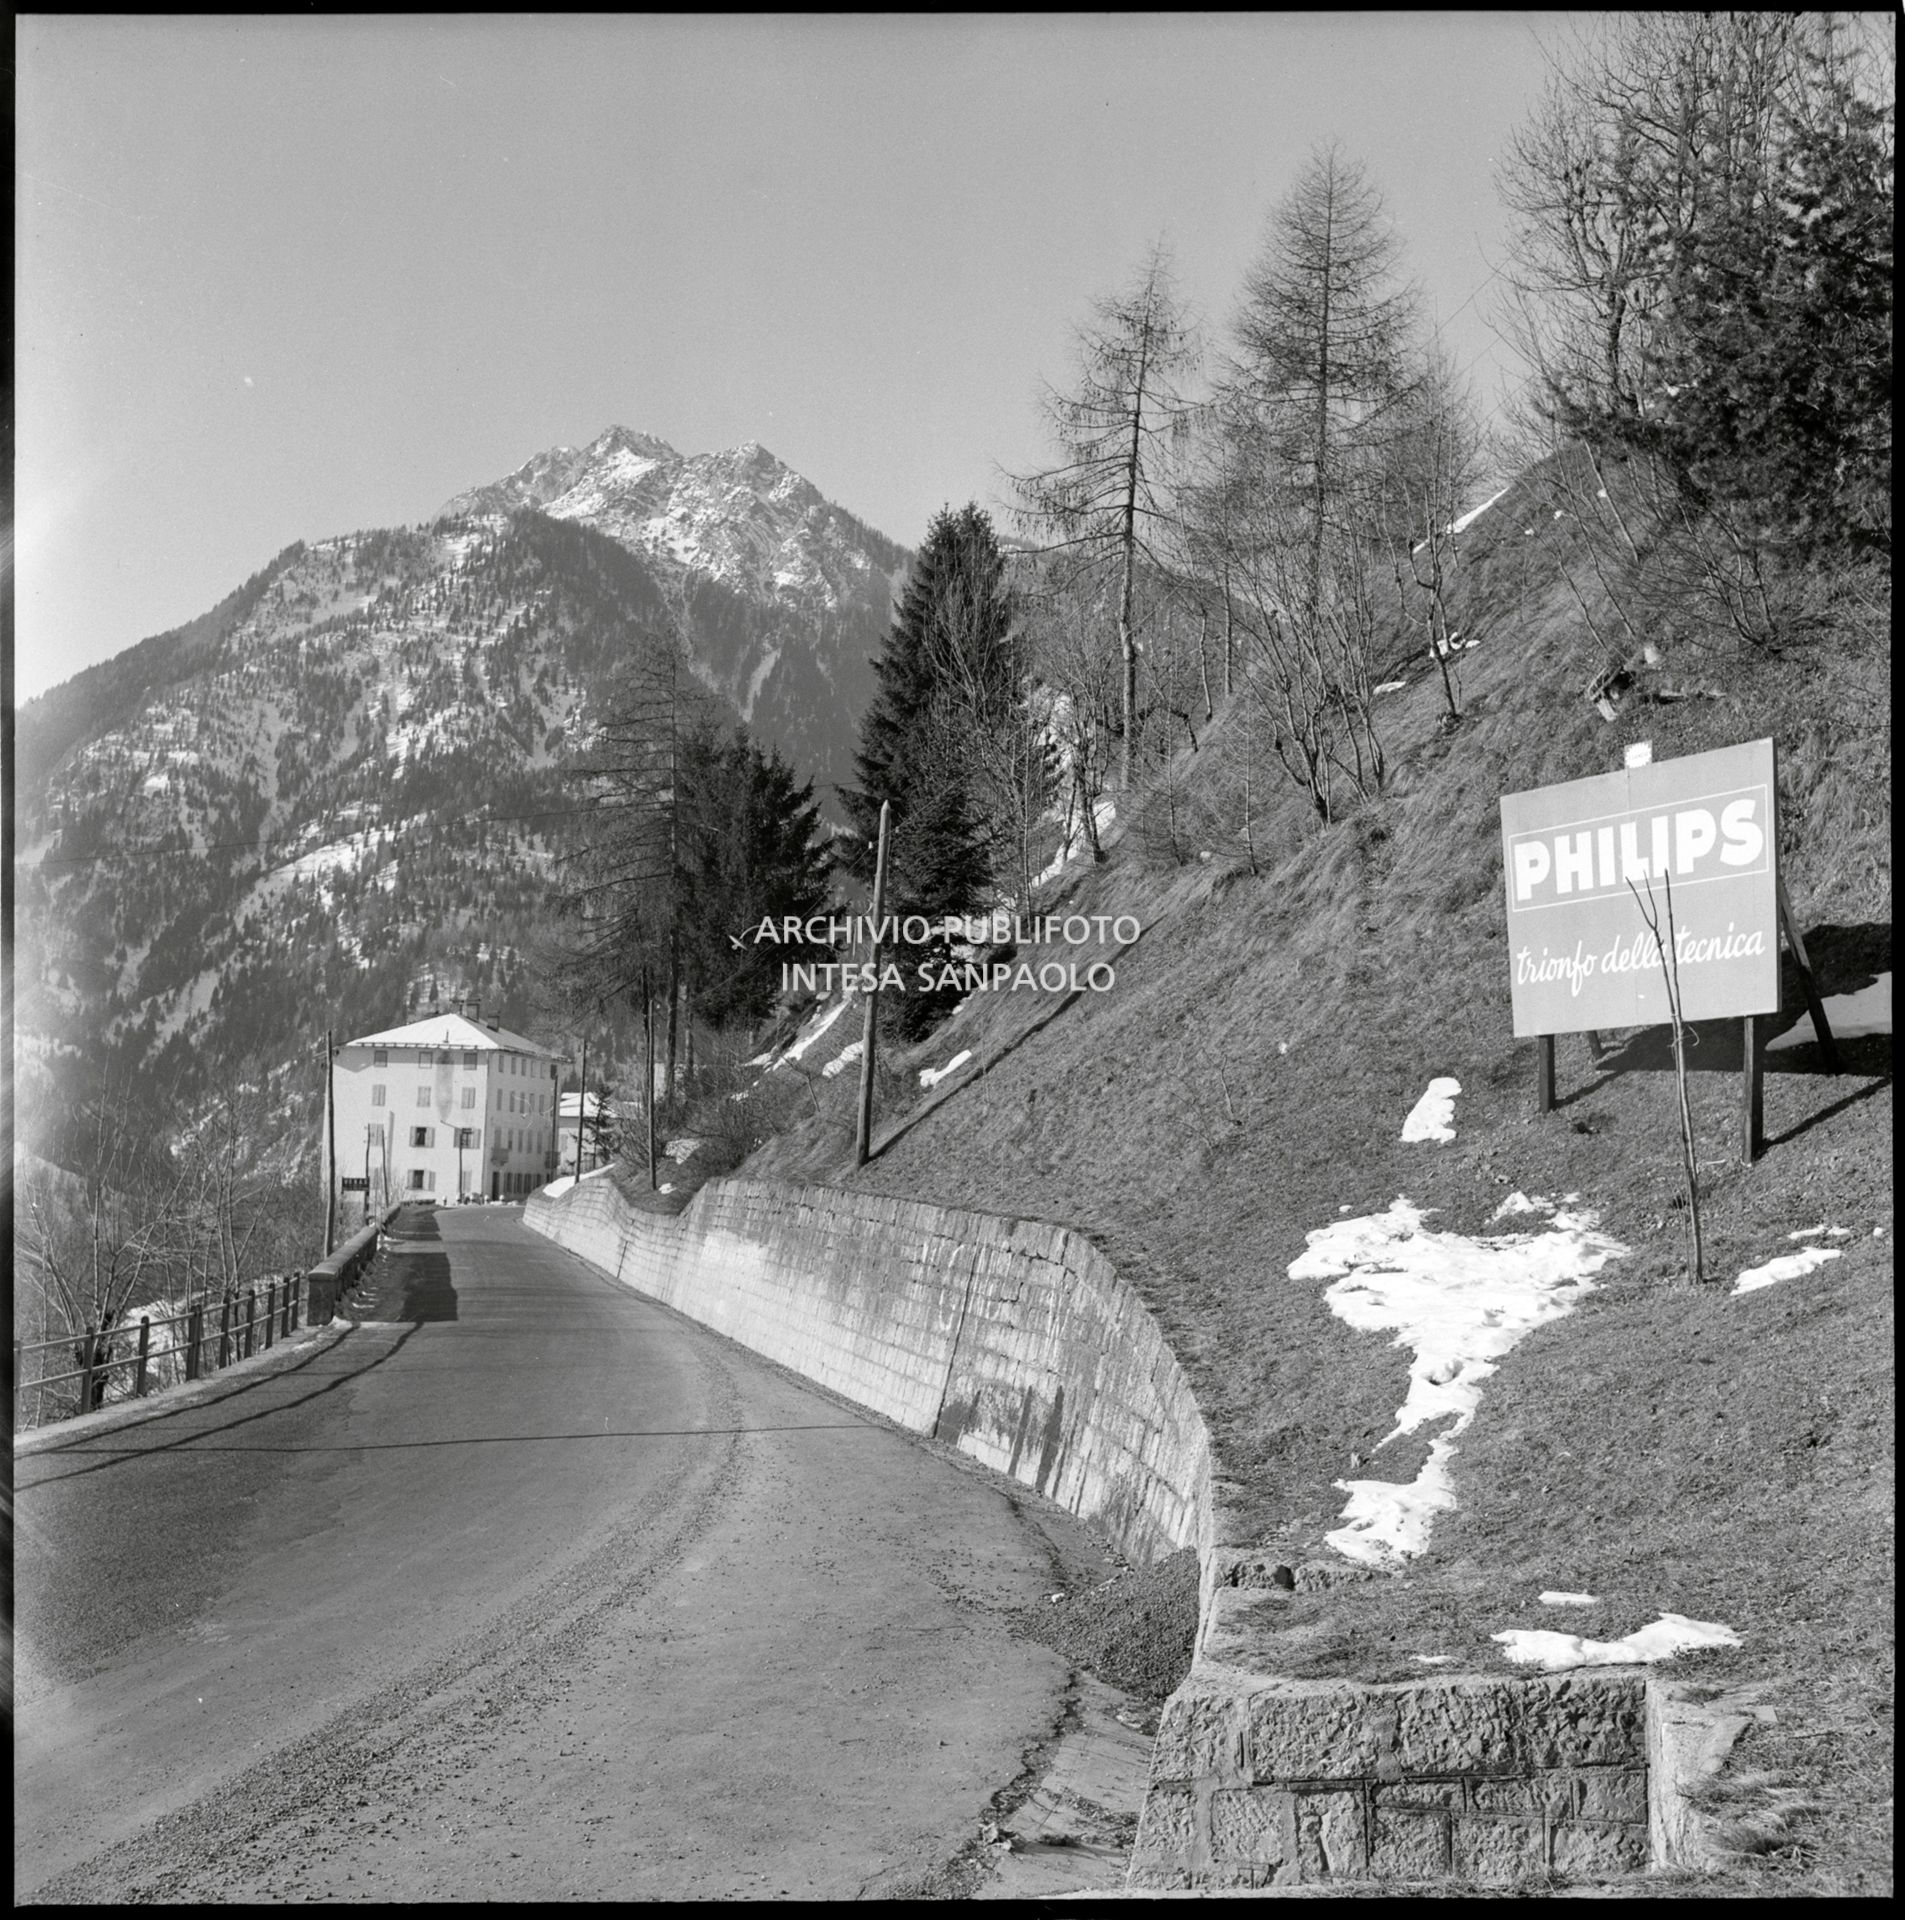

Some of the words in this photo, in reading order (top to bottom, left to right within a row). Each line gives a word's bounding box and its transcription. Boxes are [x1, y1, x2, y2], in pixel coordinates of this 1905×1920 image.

[1513, 798, 1764, 902] PHILIPS
[1516, 940, 1598, 997] trionfo
[1601, 931, 1668, 974] della
[1674, 922, 1766, 965] tecnica
